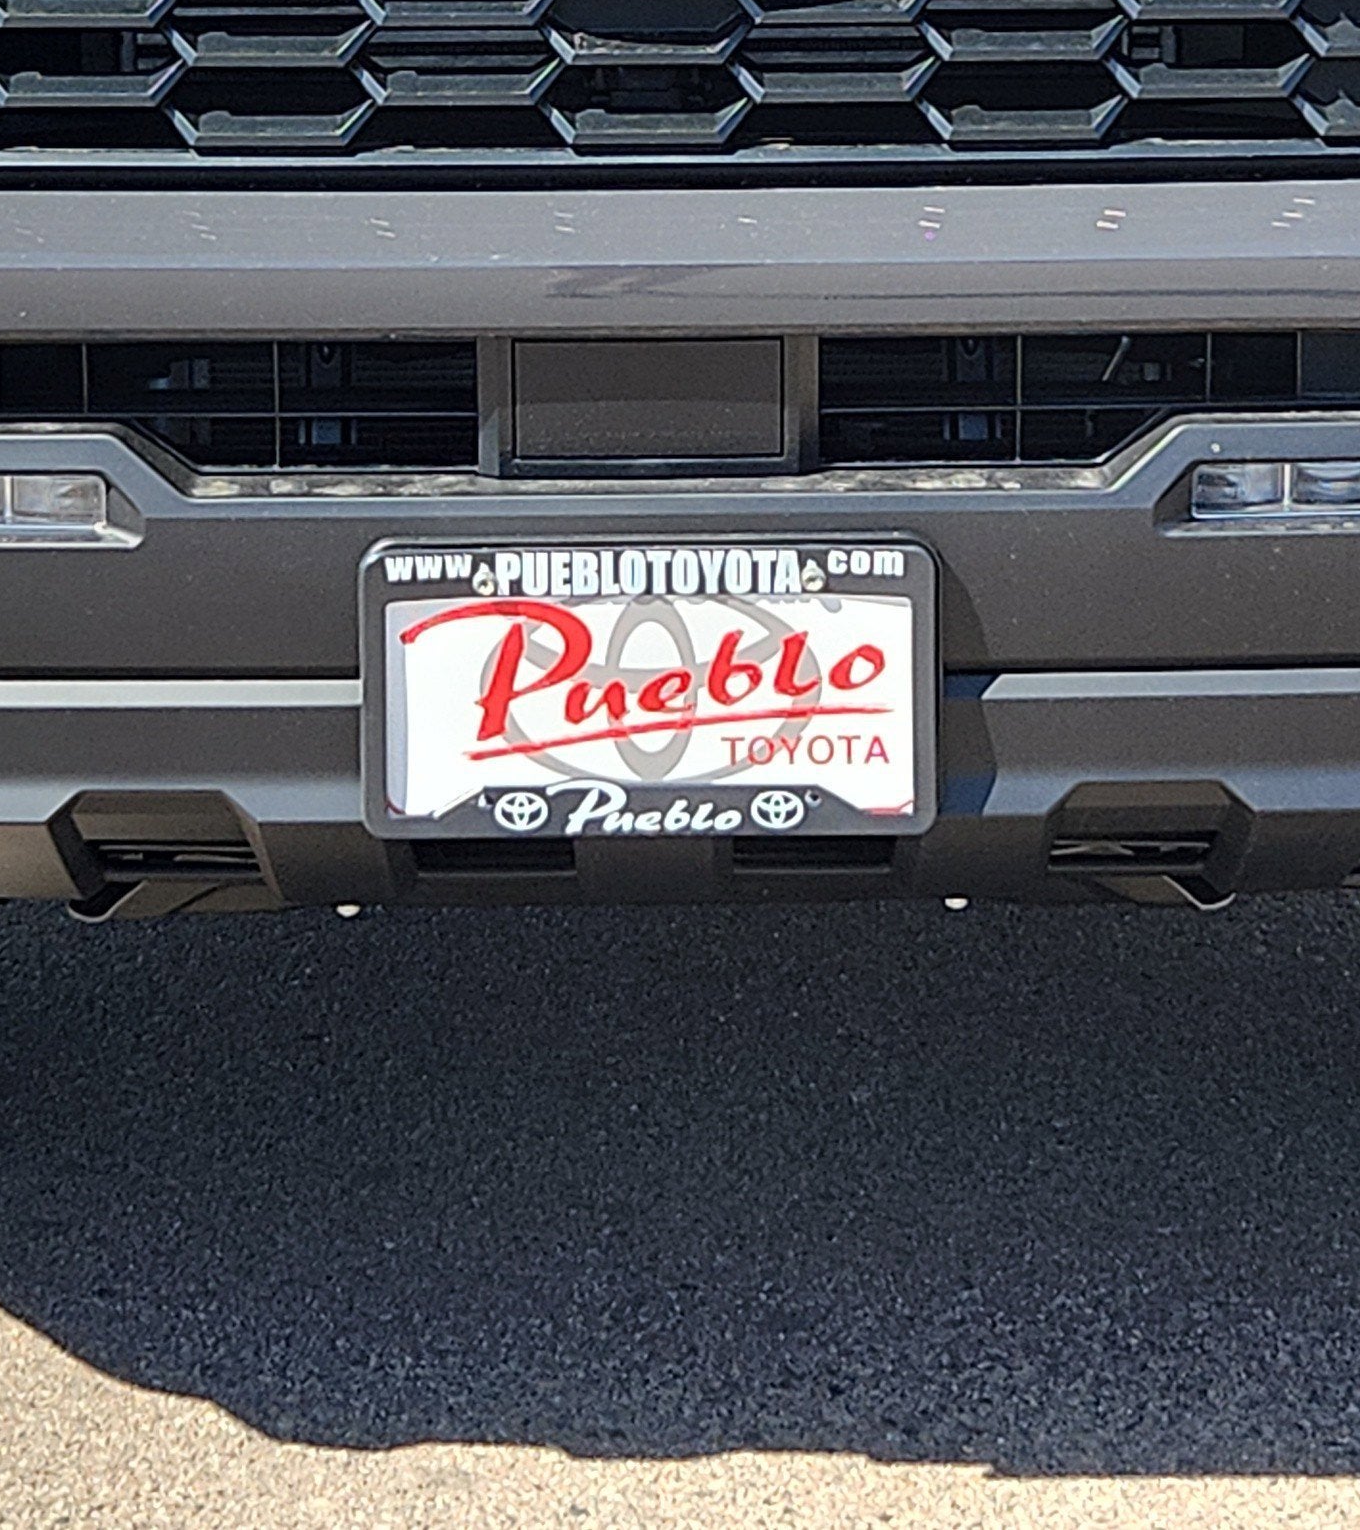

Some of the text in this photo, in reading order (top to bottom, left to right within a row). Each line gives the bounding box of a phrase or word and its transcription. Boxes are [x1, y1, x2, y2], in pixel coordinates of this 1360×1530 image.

[399, 600, 886, 741] Pueblo
[721, 735, 891, 766] TOYOTA
[545, 781, 743, 835] Pueblo
